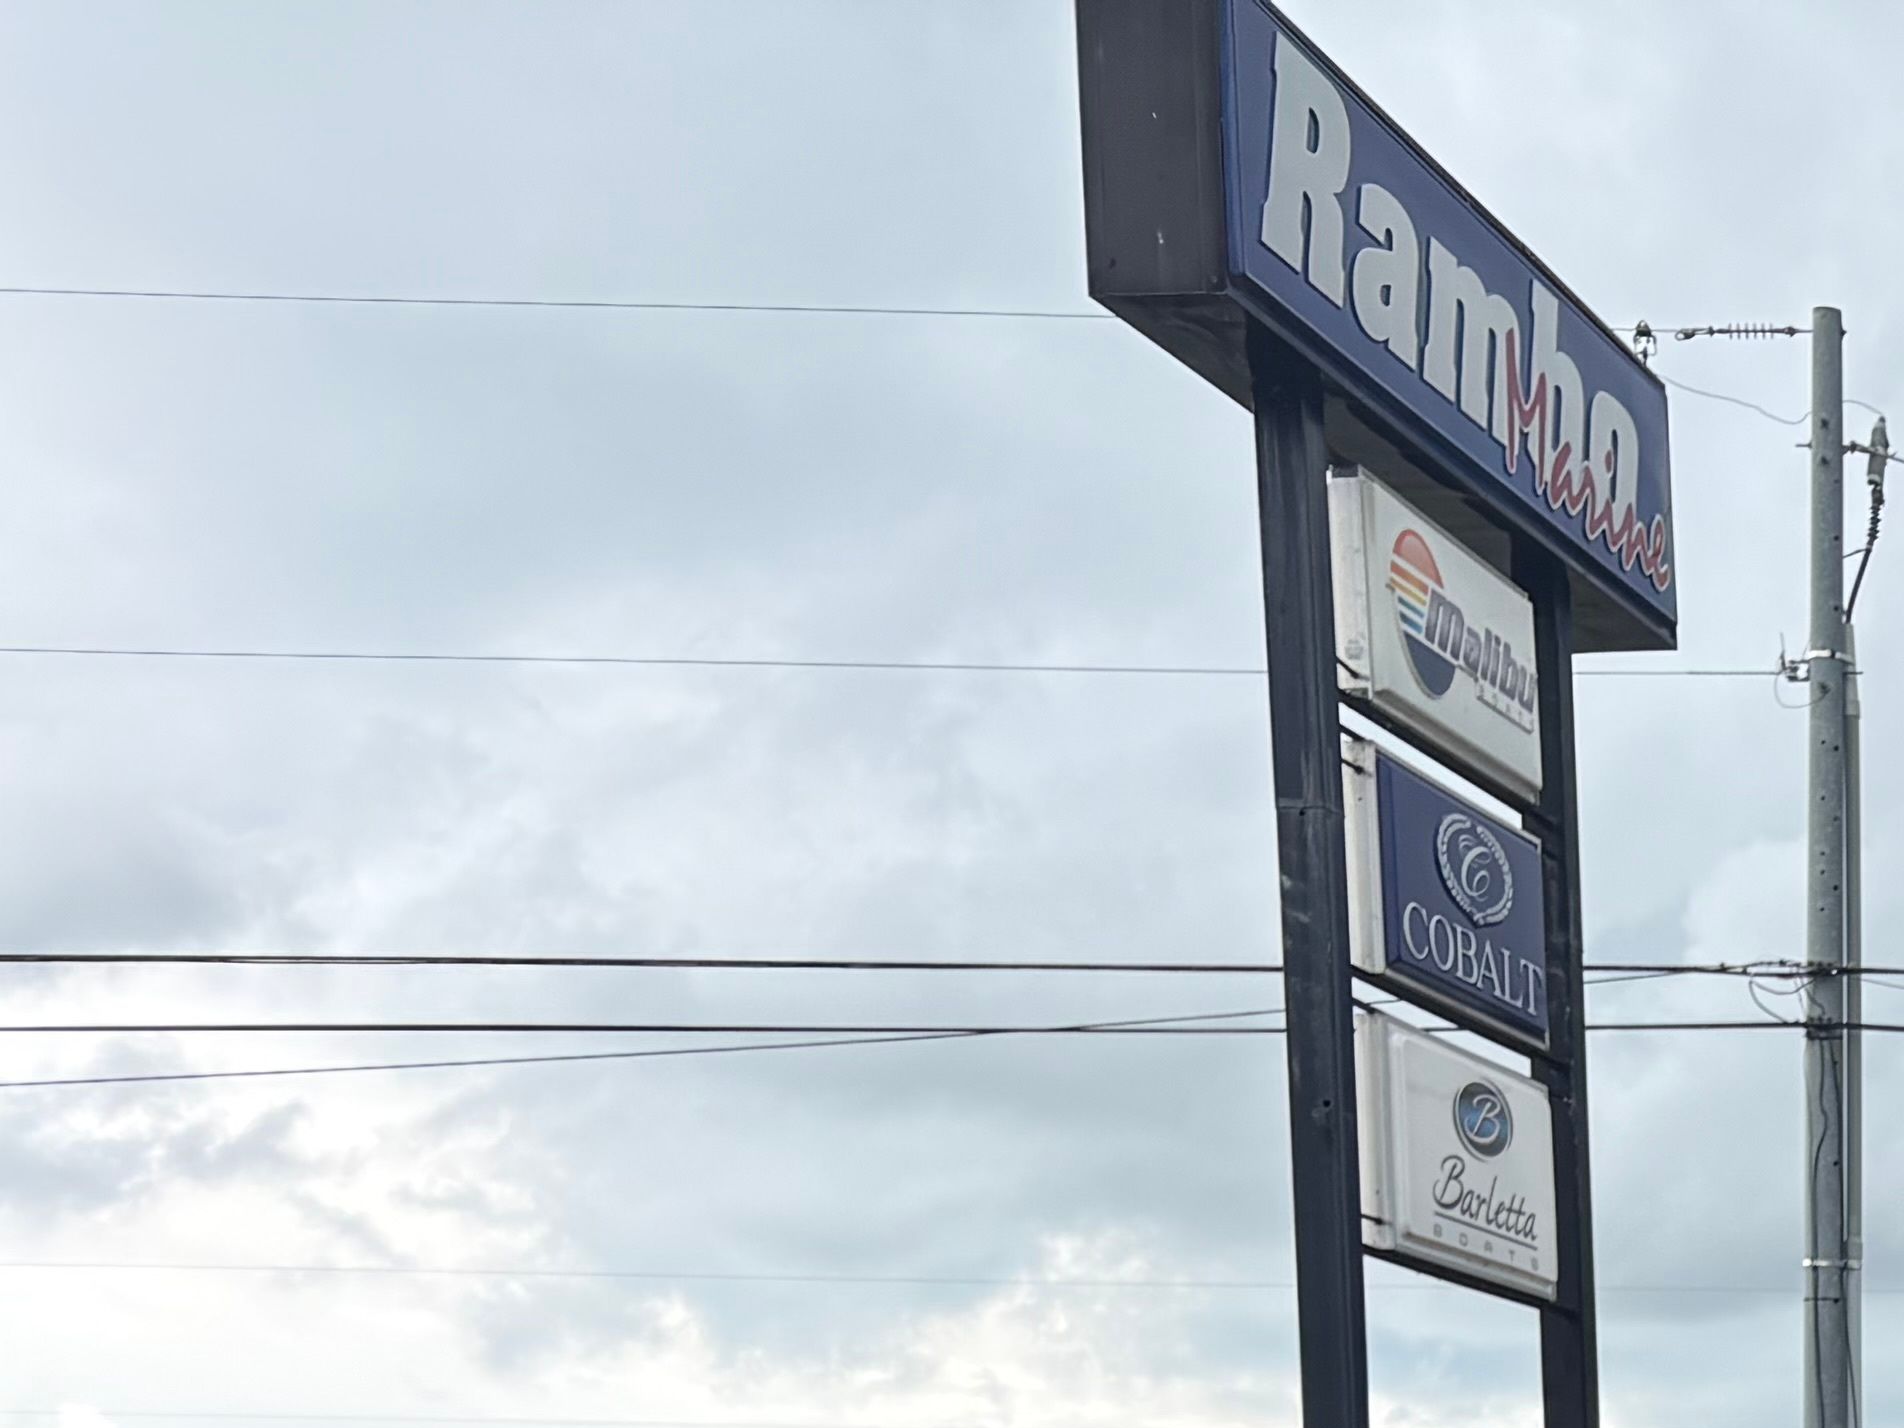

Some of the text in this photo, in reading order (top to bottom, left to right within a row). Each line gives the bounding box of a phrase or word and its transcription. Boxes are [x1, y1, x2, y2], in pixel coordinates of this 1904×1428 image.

[1261, 30, 1640, 512] Rambo
[1506, 326, 1671, 593] Marine
[1403, 901, 1543, 1016] COBALT
[1432, 1154, 1537, 1242] Barletta
[1433, 1222, 1539, 1272] BOATS
